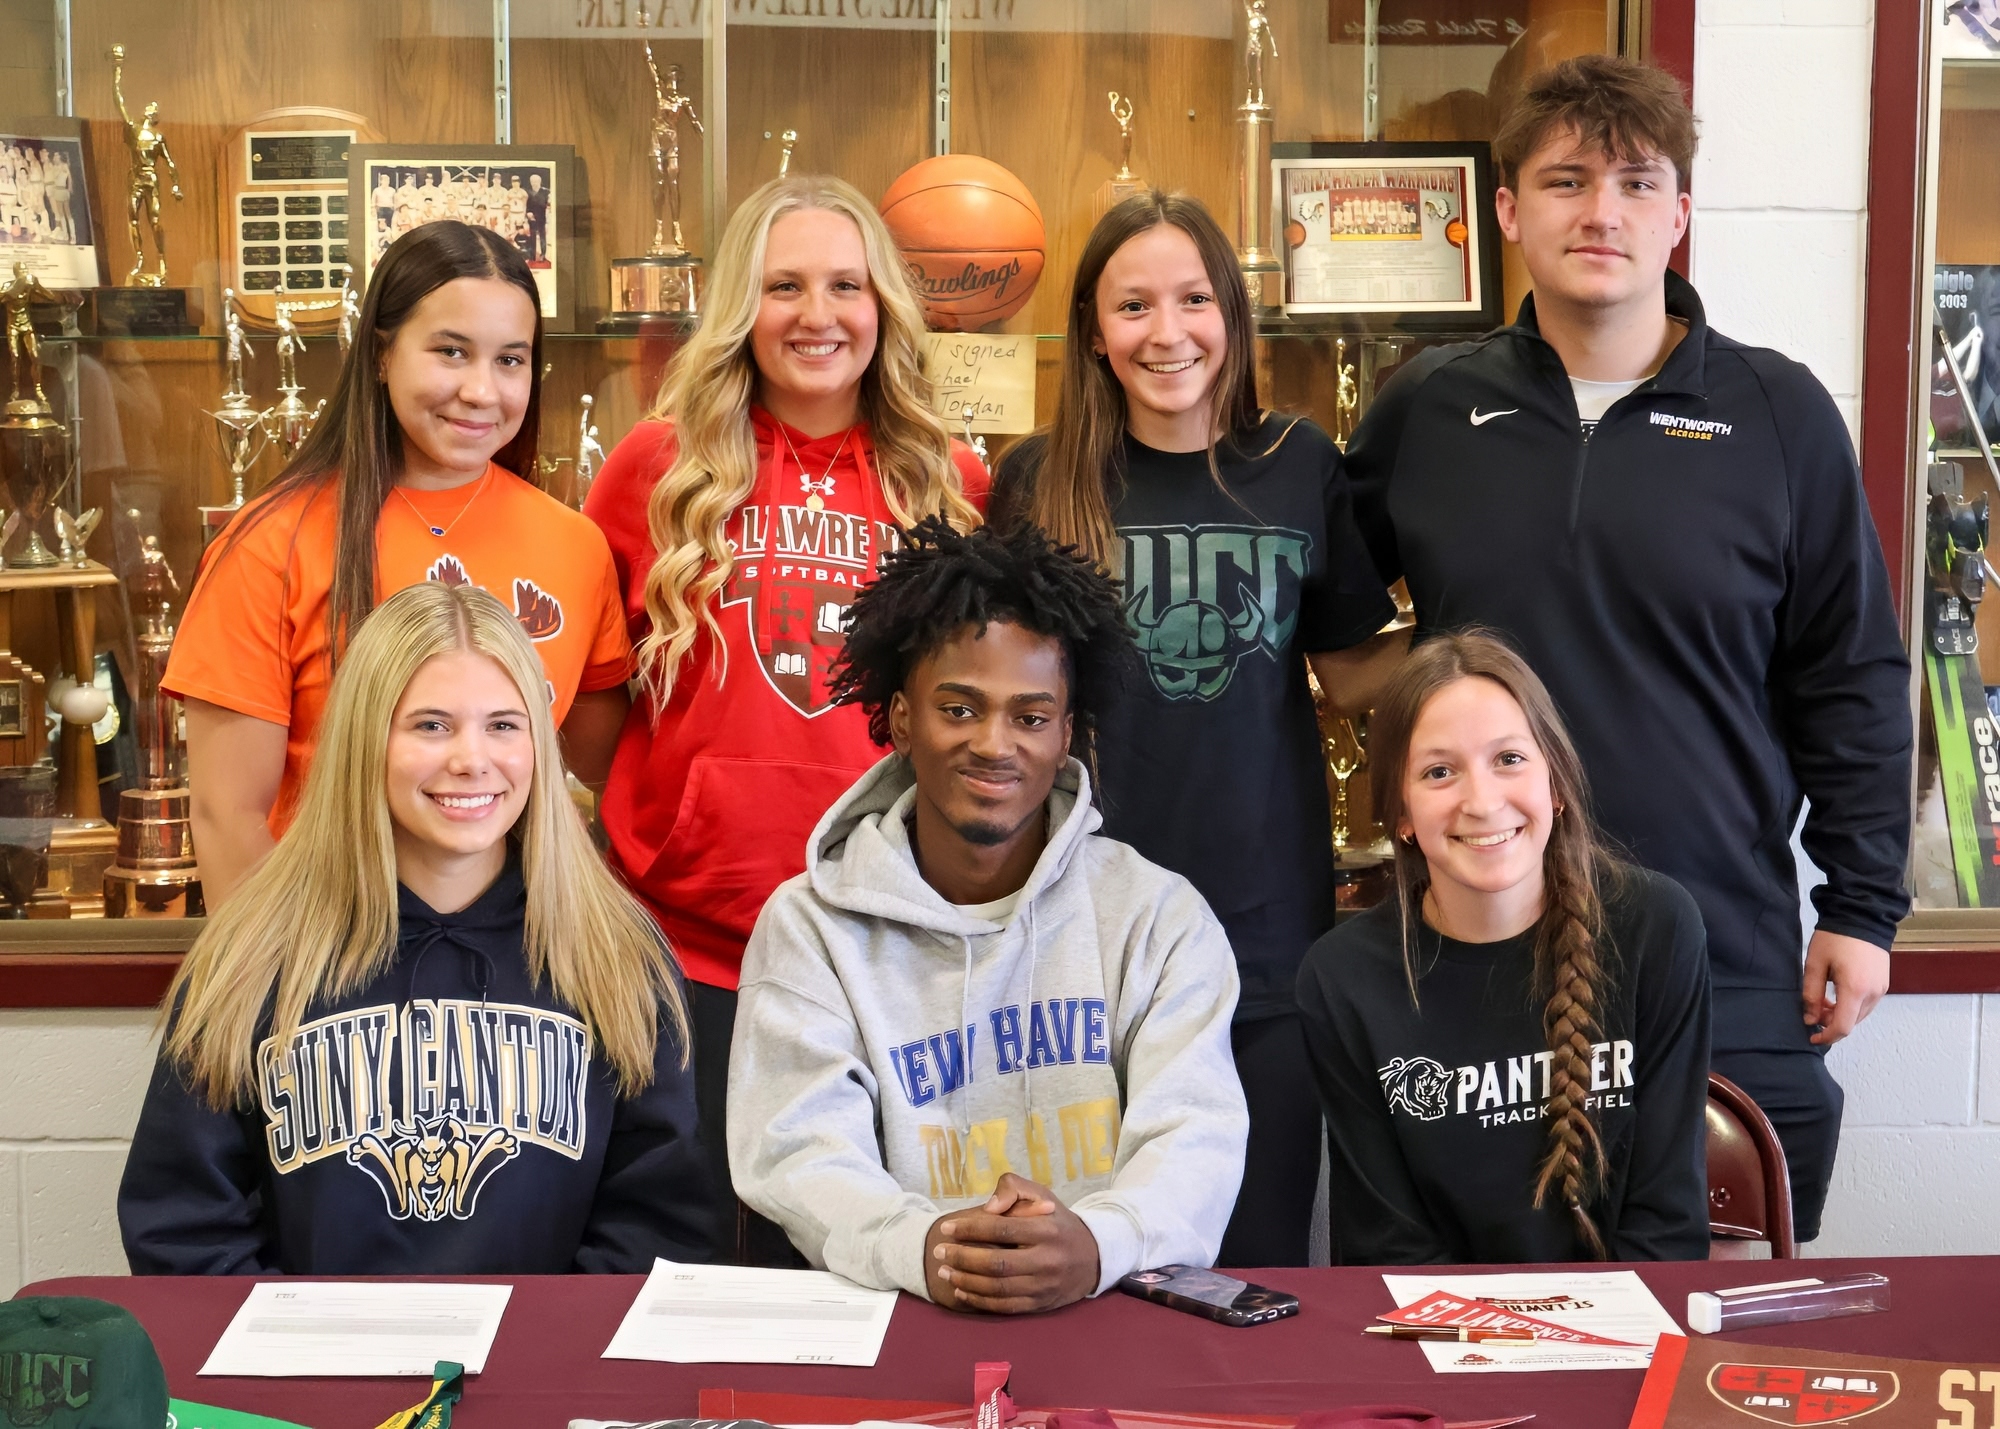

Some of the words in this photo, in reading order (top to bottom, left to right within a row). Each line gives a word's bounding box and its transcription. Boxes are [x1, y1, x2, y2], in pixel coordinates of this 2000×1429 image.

[950, 341, 1019, 367] signed
[1650, 411, 1733, 436] WENTWORTH
[1664, 427, 1713, 441] LACROSSE
[745, 565, 865, 589] SFTBAL
[258, 1003, 398, 1175] SUNY
[400, 998, 592, 1161] CANTON
[1456, 1039, 1635, 1115] PANTER
[1479, 1103, 1550, 1129] TRACK
